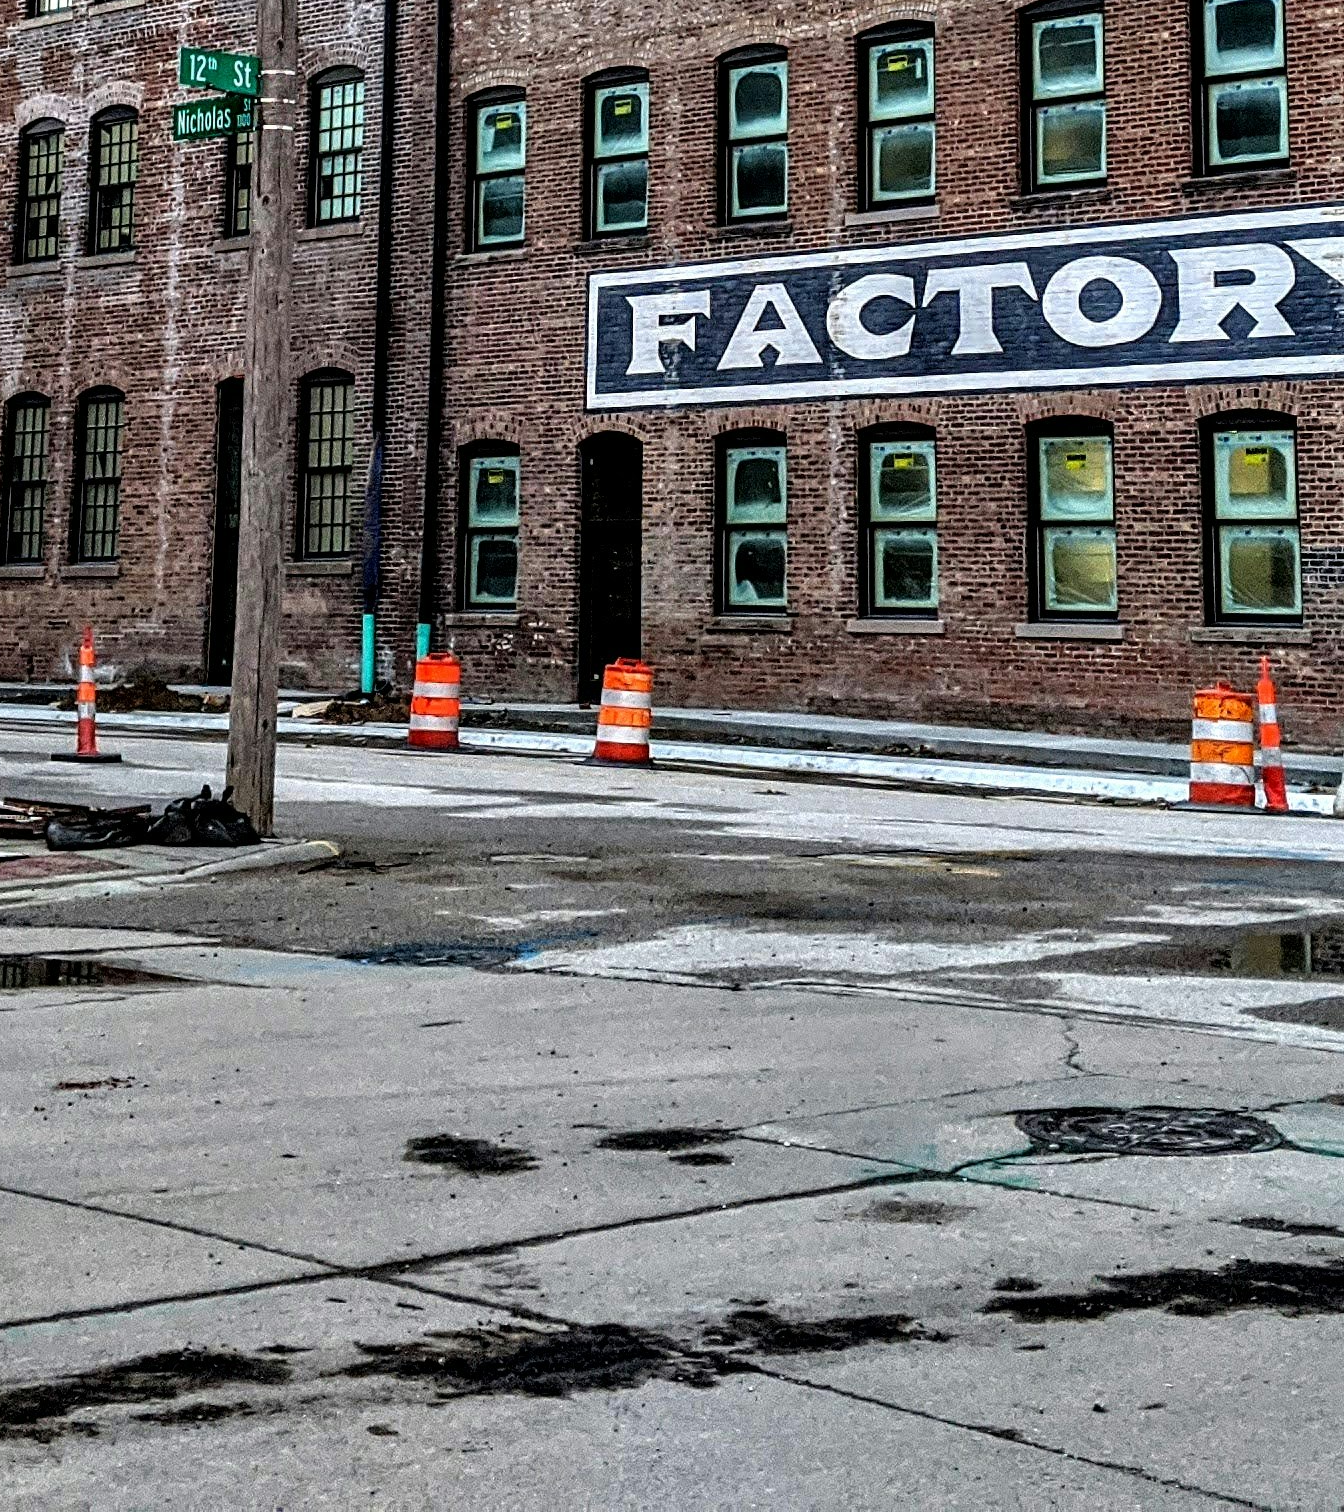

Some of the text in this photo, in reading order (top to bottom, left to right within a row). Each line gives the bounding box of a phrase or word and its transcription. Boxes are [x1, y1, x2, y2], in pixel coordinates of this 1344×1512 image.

[189, 54, 252, 88] 12th St
[177, 105, 232, 136] Nicholas
